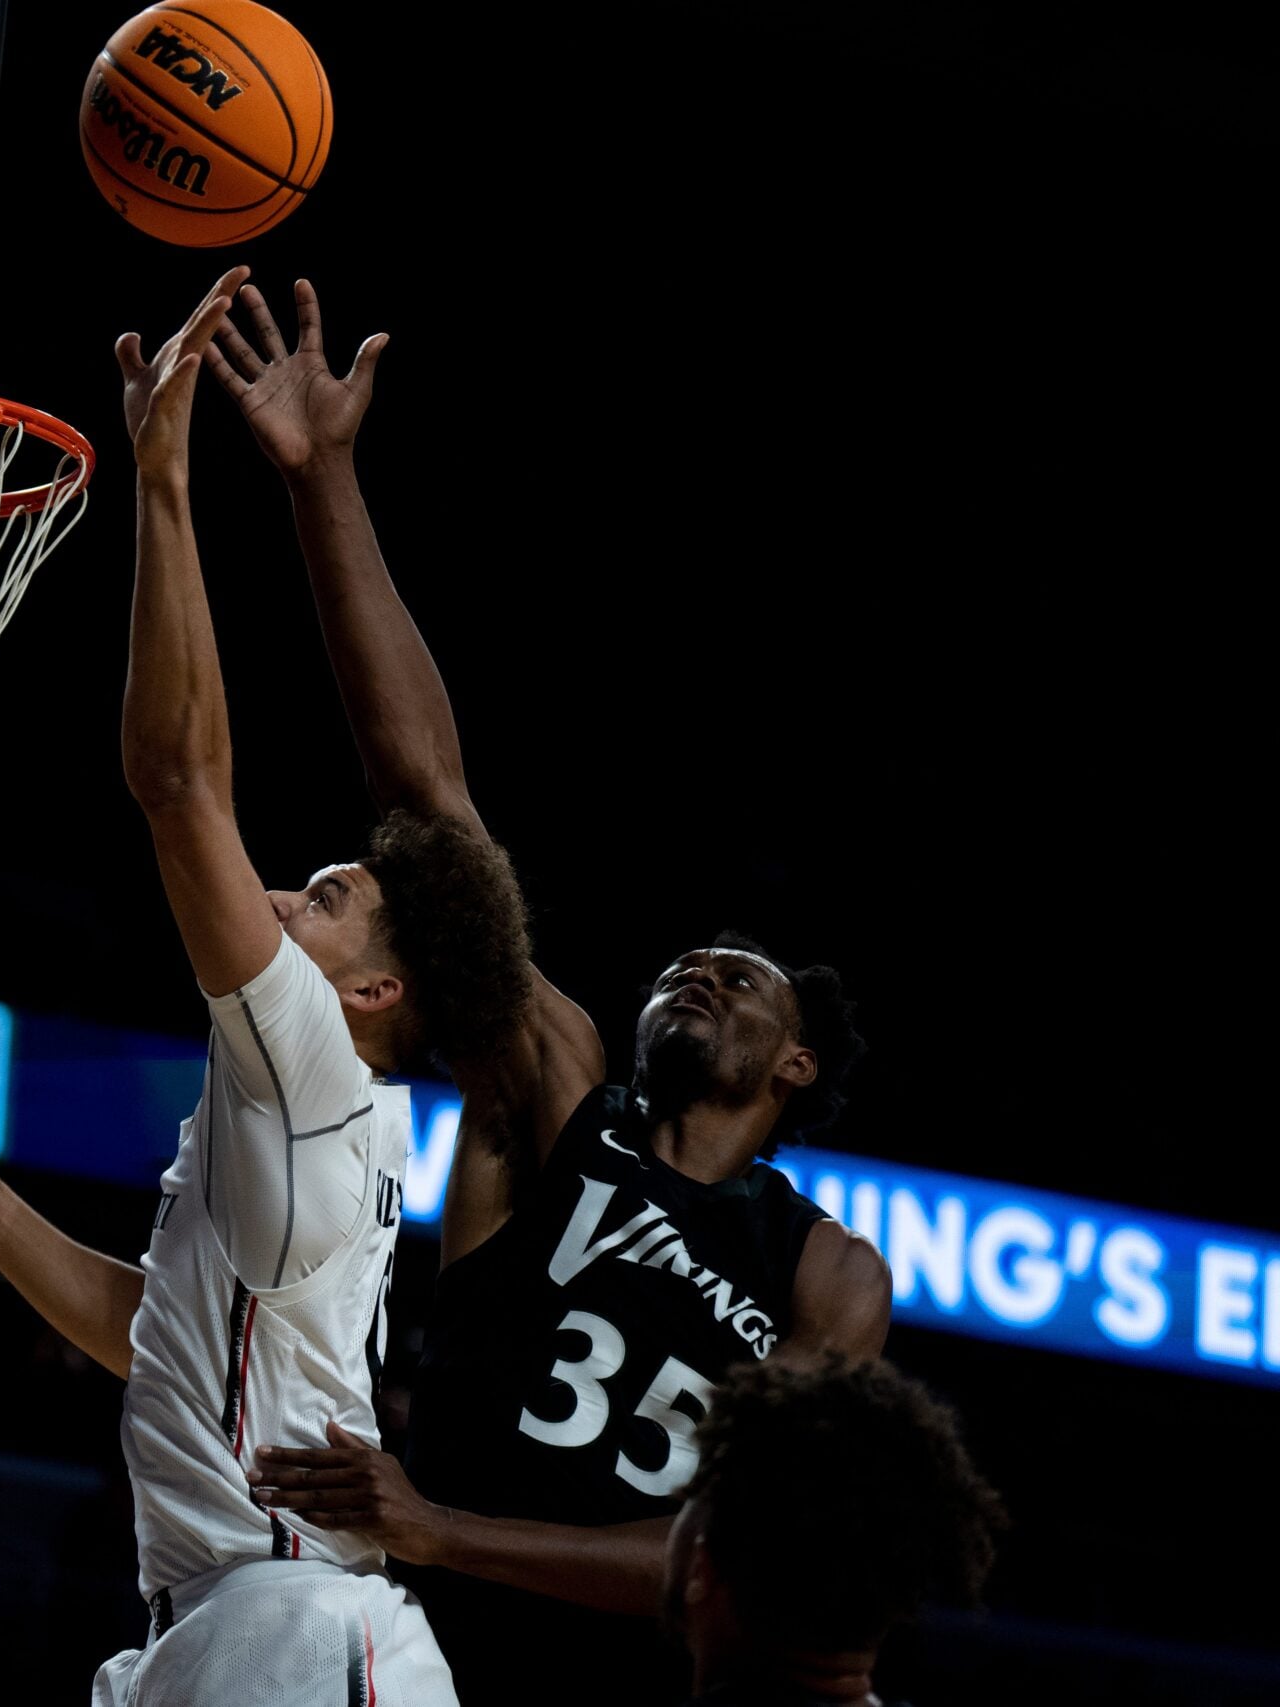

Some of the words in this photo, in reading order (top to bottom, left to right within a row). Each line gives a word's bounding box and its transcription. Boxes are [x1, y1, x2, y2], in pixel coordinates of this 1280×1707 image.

[90, 71, 211, 196] Wilson
[134, 24, 243, 113] NCAA
[547, 1173, 778, 1361] VIKINGS
[518, 1309, 721, 1497] 35
